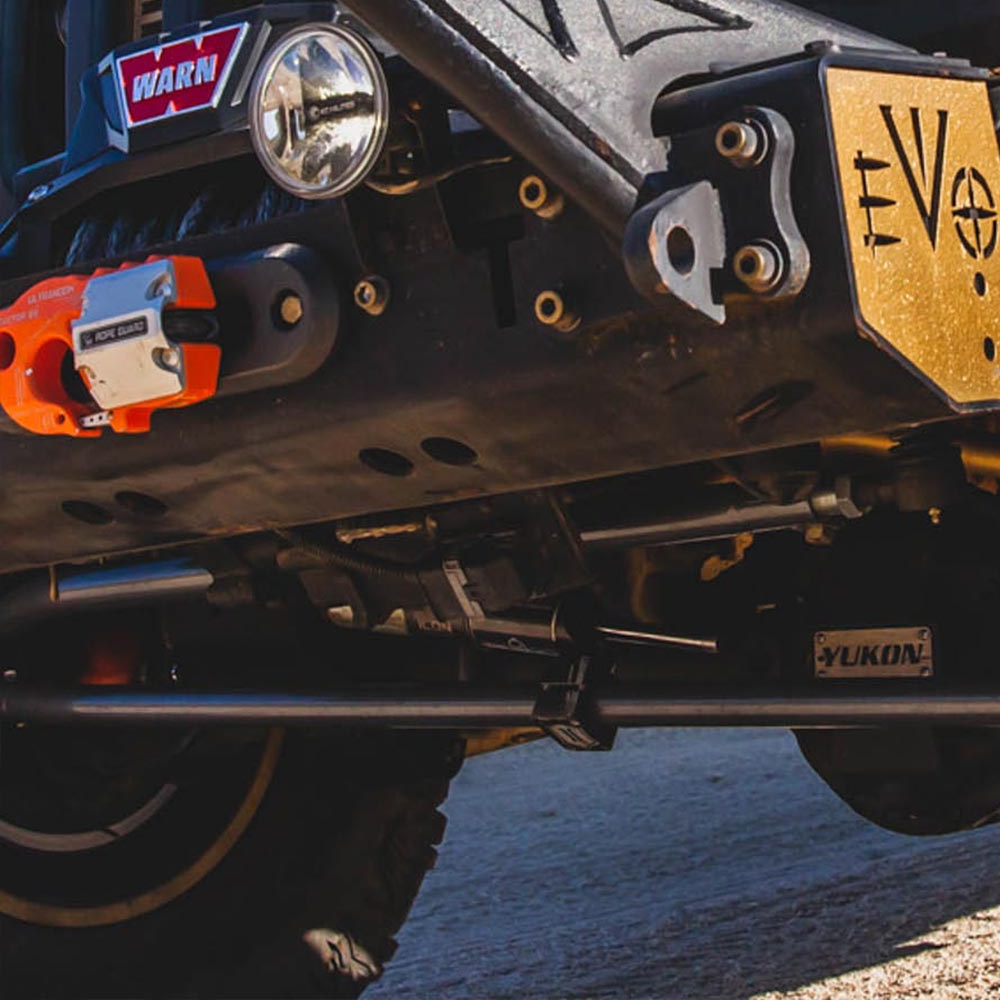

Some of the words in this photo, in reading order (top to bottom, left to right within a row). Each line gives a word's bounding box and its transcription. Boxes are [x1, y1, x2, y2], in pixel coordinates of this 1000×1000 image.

[132, 53, 218, 102] WARN
[853, 104, 998, 260] EVO
[95, 327, 117, 341] ROPE
[117, 320, 145, 336] GUARD
[822, 643, 924, 667] YUKON
